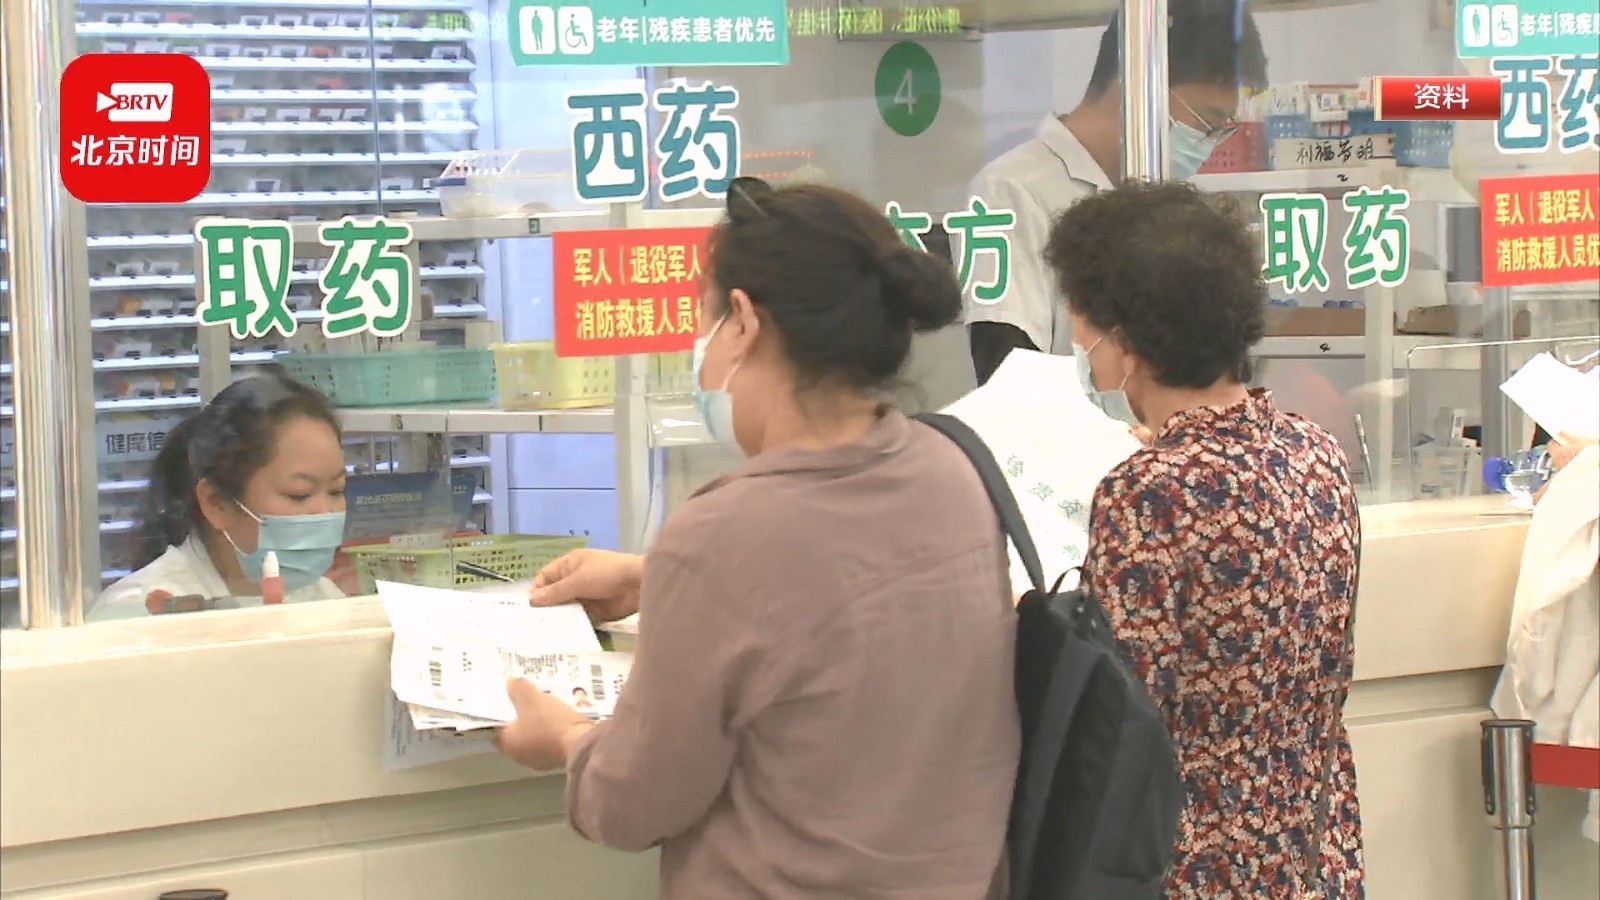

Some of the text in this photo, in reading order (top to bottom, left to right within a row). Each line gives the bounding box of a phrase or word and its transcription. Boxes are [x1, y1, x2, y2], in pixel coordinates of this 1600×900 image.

[565, 82, 740, 200] 西药
[894, 68, 917, 114] 4
[196, 216, 413, 340] 取药
[1262, 186, 1410, 293] 取药
